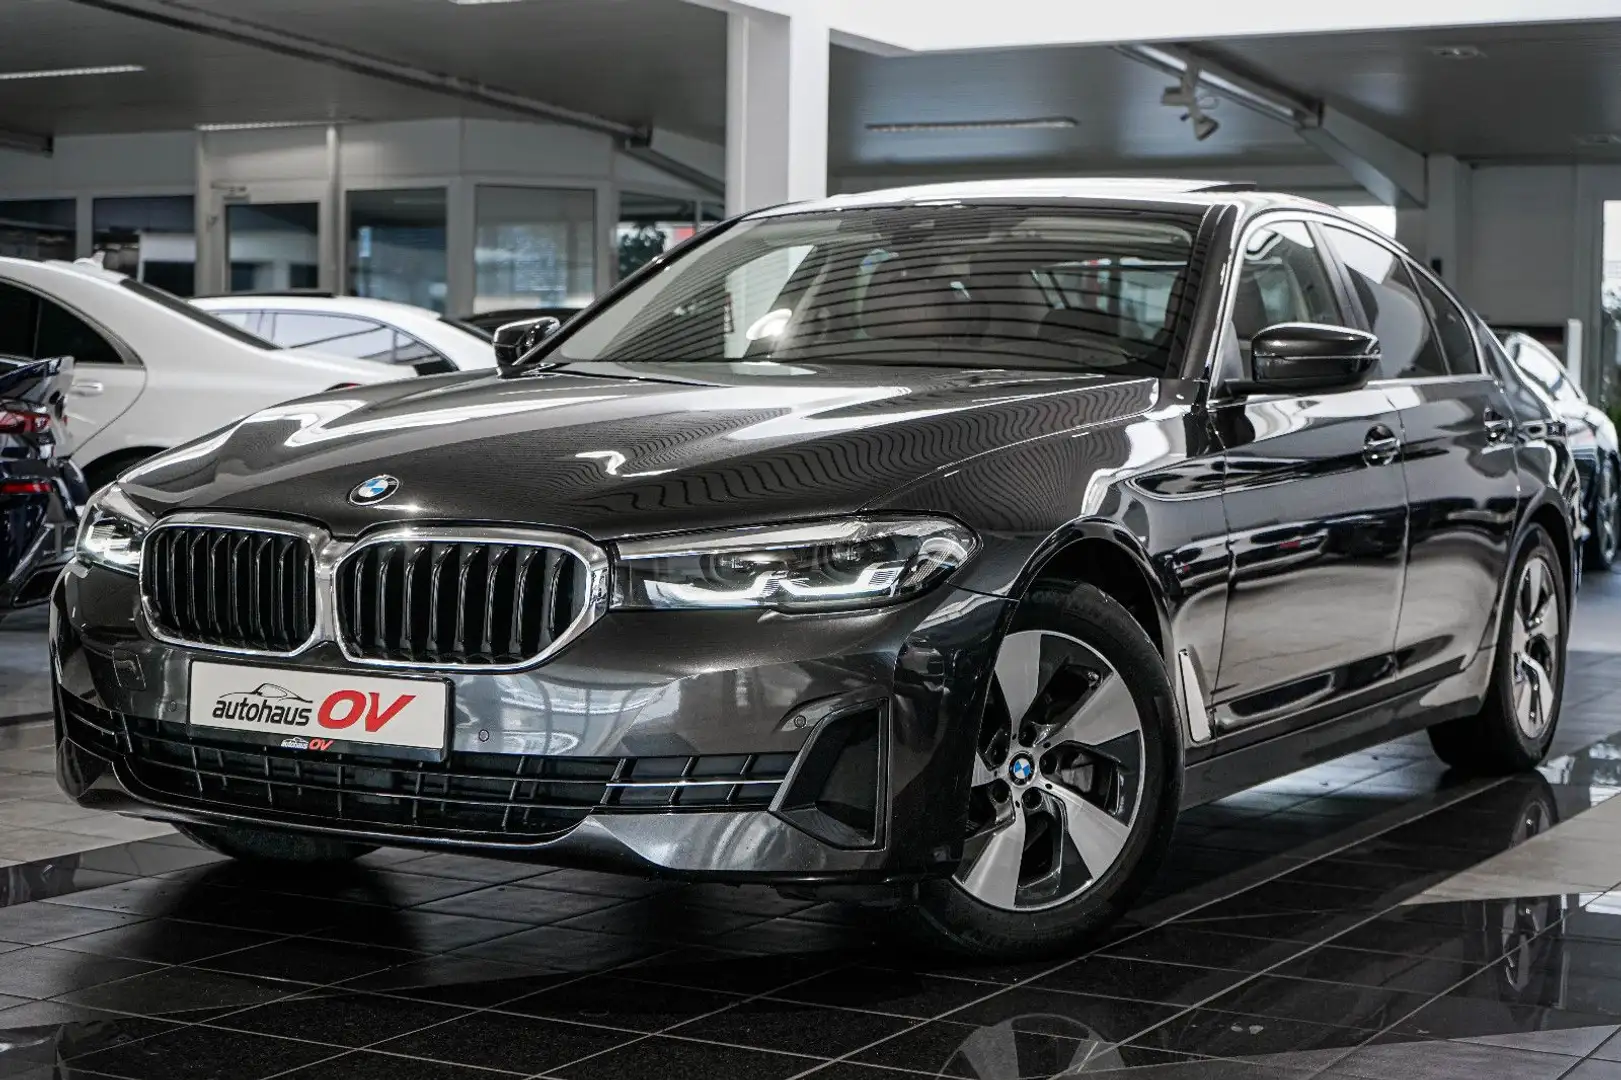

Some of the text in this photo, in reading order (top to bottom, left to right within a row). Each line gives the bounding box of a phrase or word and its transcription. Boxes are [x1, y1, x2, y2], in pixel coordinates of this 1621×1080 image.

[212, 690, 416, 732] autohaus OV
[309, 738, 334, 750] OV
